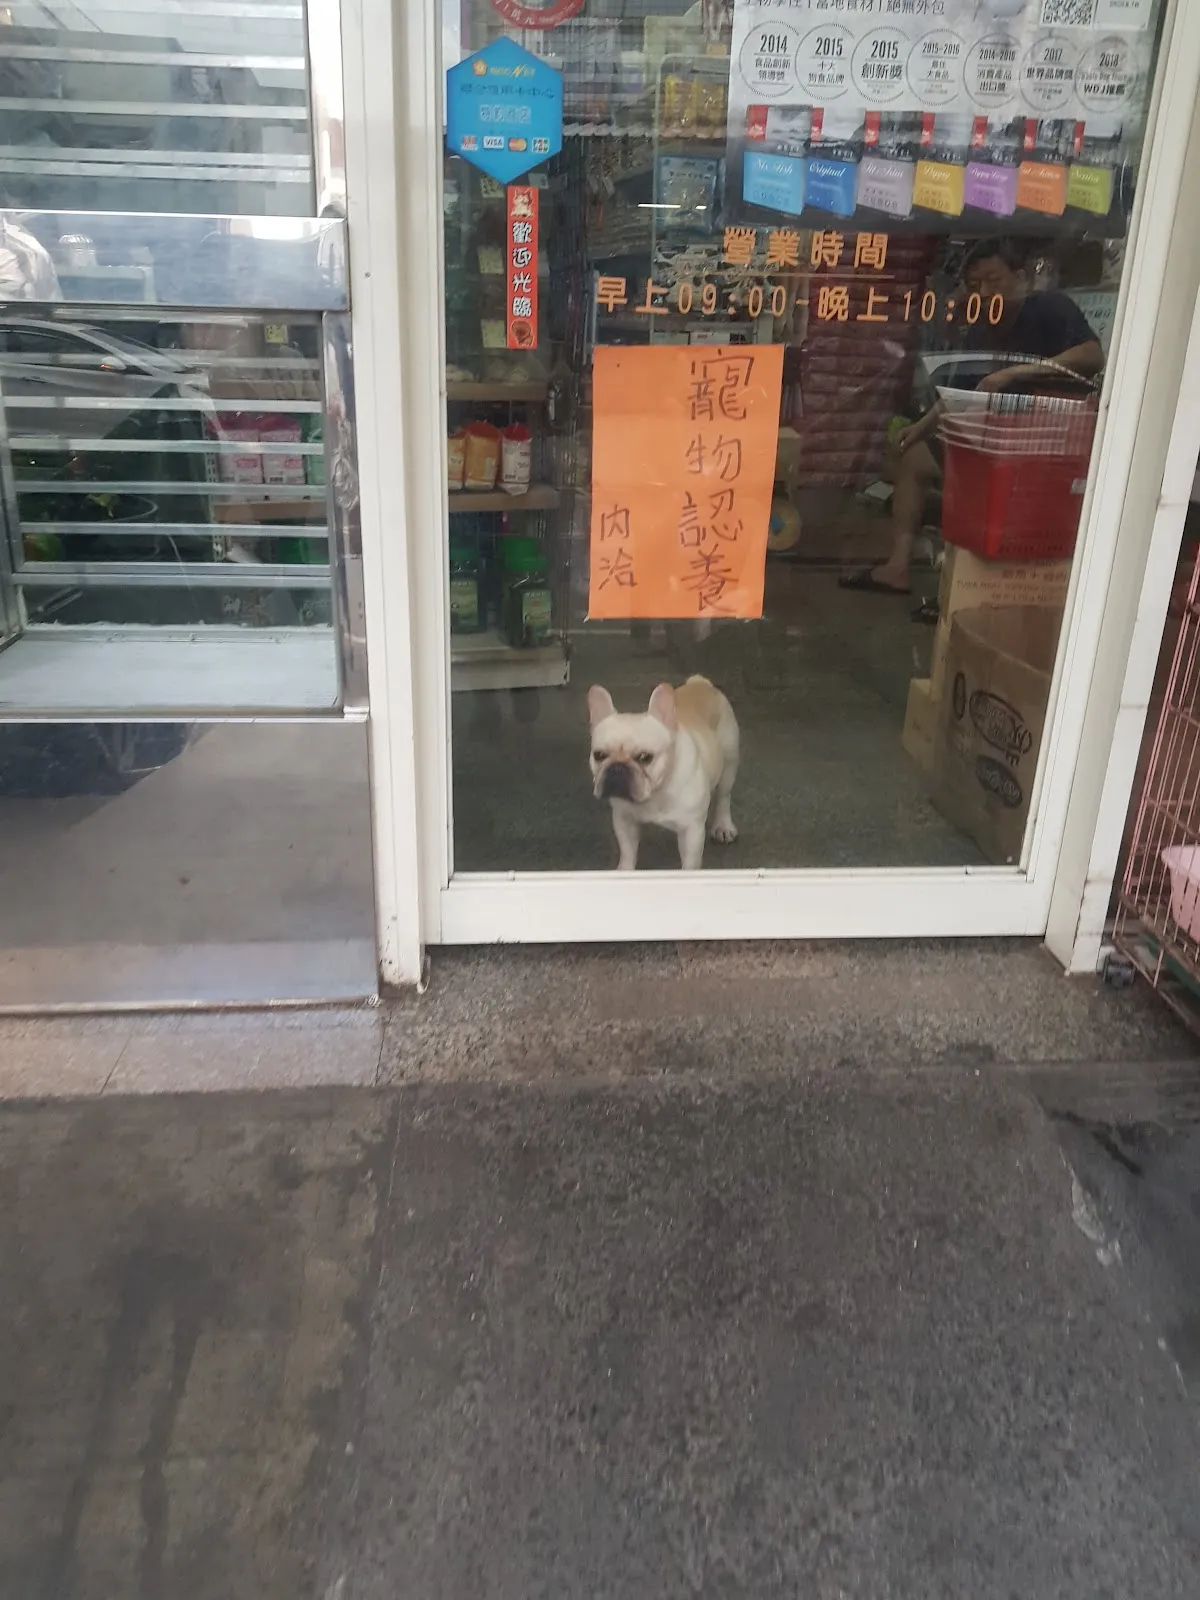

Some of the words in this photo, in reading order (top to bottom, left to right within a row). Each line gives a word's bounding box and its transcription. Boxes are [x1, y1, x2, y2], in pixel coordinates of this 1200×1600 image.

[760, 34, 788, 54] 2014
[815, 37, 844, 56] 2015
[871, 40, 899, 59] 2015
[1043, 48, 1063, 61] 2017
[1100, 53, 1119, 67] 2018
[818, 60, 836, 71] 十大
[861, 63, 903, 81] 創新獎
[808, 73, 845, 84] 狗食品牌
[485, 137, 503, 147] VISA
[809, 161, 847, 178] Original
[723, 225, 889, 270] 營業時間
[511, 220, 532, 318] 歡迎光臨
[677, 348, 755, 614] 寵物認養
